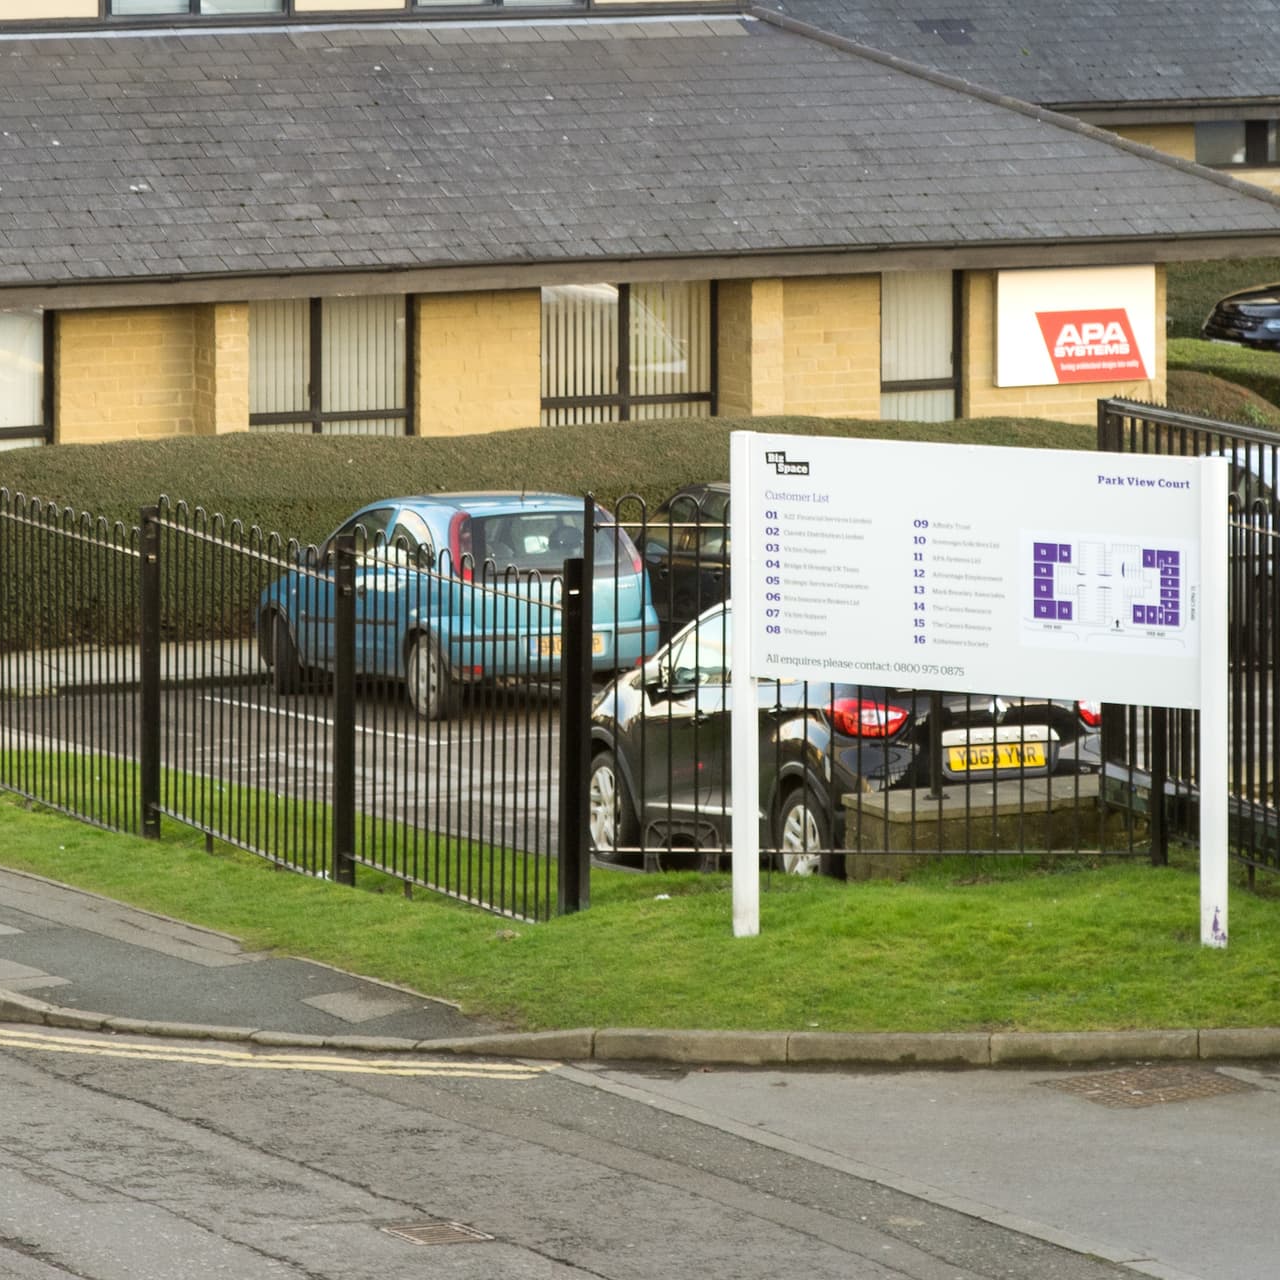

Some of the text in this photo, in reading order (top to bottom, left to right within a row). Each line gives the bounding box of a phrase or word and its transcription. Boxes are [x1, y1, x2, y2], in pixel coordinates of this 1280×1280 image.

[1055, 322, 1128, 345] APA
[1054, 343, 1130, 358] SYSTEMS
[768, 453, 785, 462] Biz
[778, 463, 808, 474] Space
[1098, 475, 1190, 489] Park View Court
[765, 490, 829, 503] Customer List
[765, 511, 778, 520] 01
[913, 519, 929, 529] 09
[765, 527, 780, 536] 02
[913, 536, 926, 544] 10
[765, 543, 780, 552] 03
[913, 552, 923, 561] 11
[765, 560, 780, 568] 04
[913, 569, 925, 578] 12
[766, 576, 780, 585] 05
[914, 585, 925, 594] 13
[766, 592, 781, 601] 06
[914, 602, 925, 611] 14
[766, 608, 780, 618] 07
[914, 618, 925, 627] 15
[766, 625, 781, 634] 08
[914, 635, 926, 644] 16
[766, 653, 779, 664] All
[780, 656, 821, 667] enquires
[822, 657, 853, 669] please
[893, 662, 920, 674] 0800
[921, 664, 940, 675] 975
[940, 665, 965, 677] 0875
